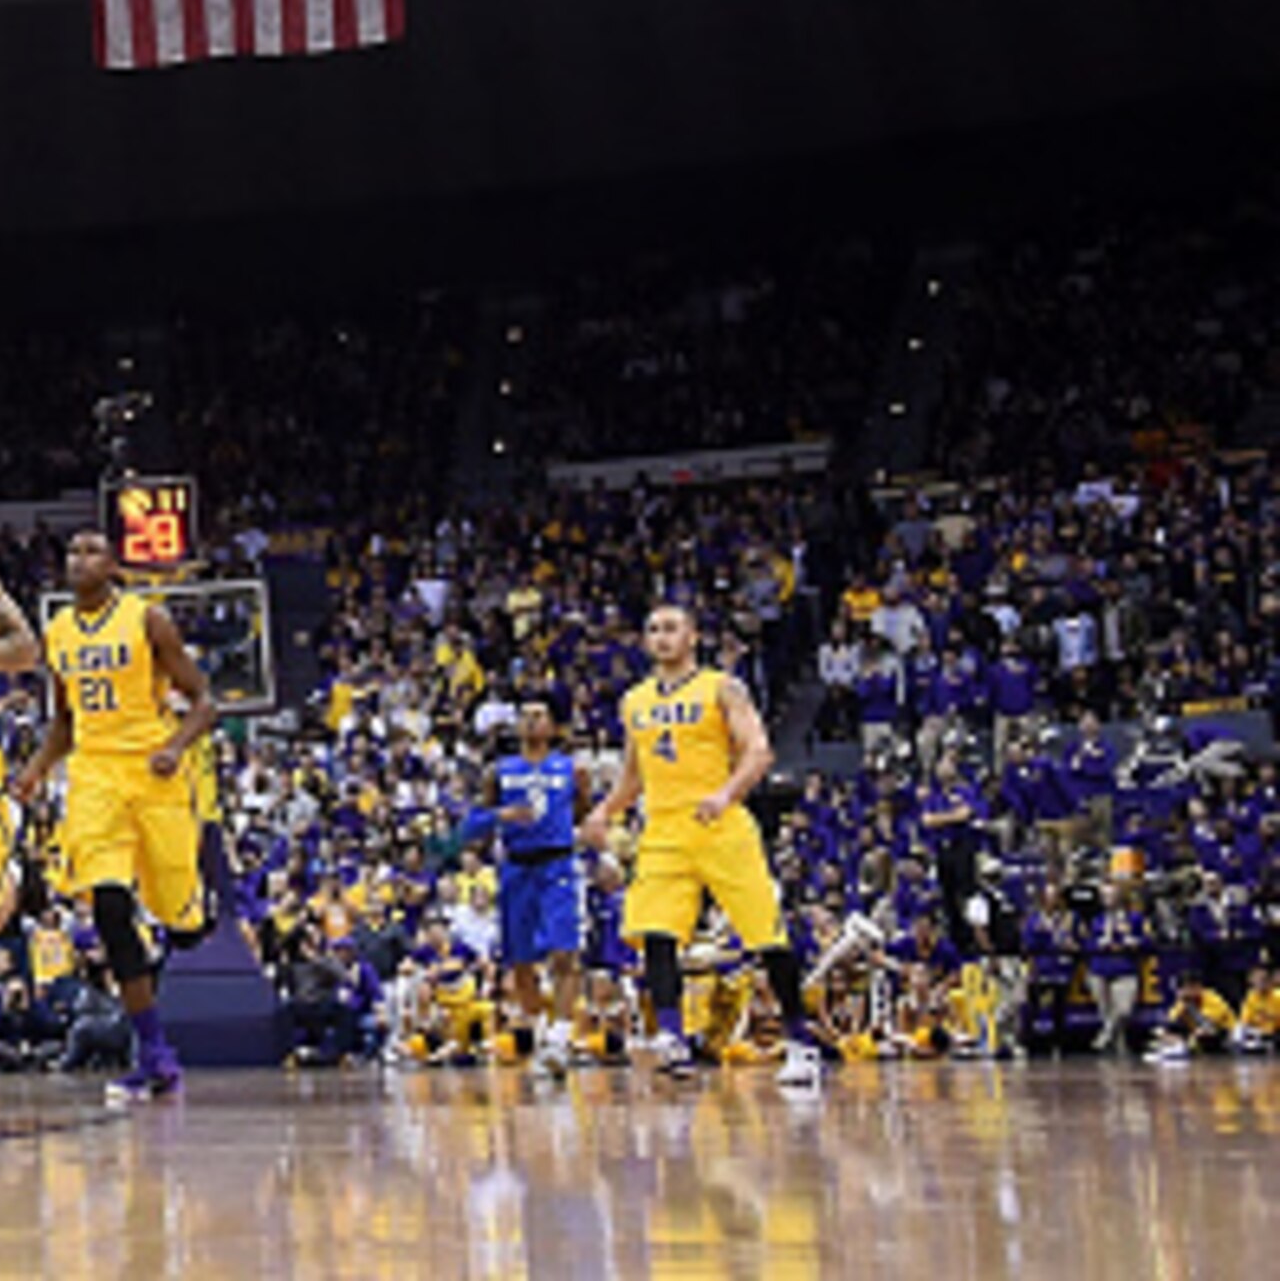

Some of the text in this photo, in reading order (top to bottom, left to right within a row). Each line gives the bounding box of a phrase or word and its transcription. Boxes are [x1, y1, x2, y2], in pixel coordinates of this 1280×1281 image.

[58, 643, 130, 675] LSU
[78, 676, 118, 712] 21
[632, 702, 701, 730] LSU
[652, 729, 678, 762] 4
